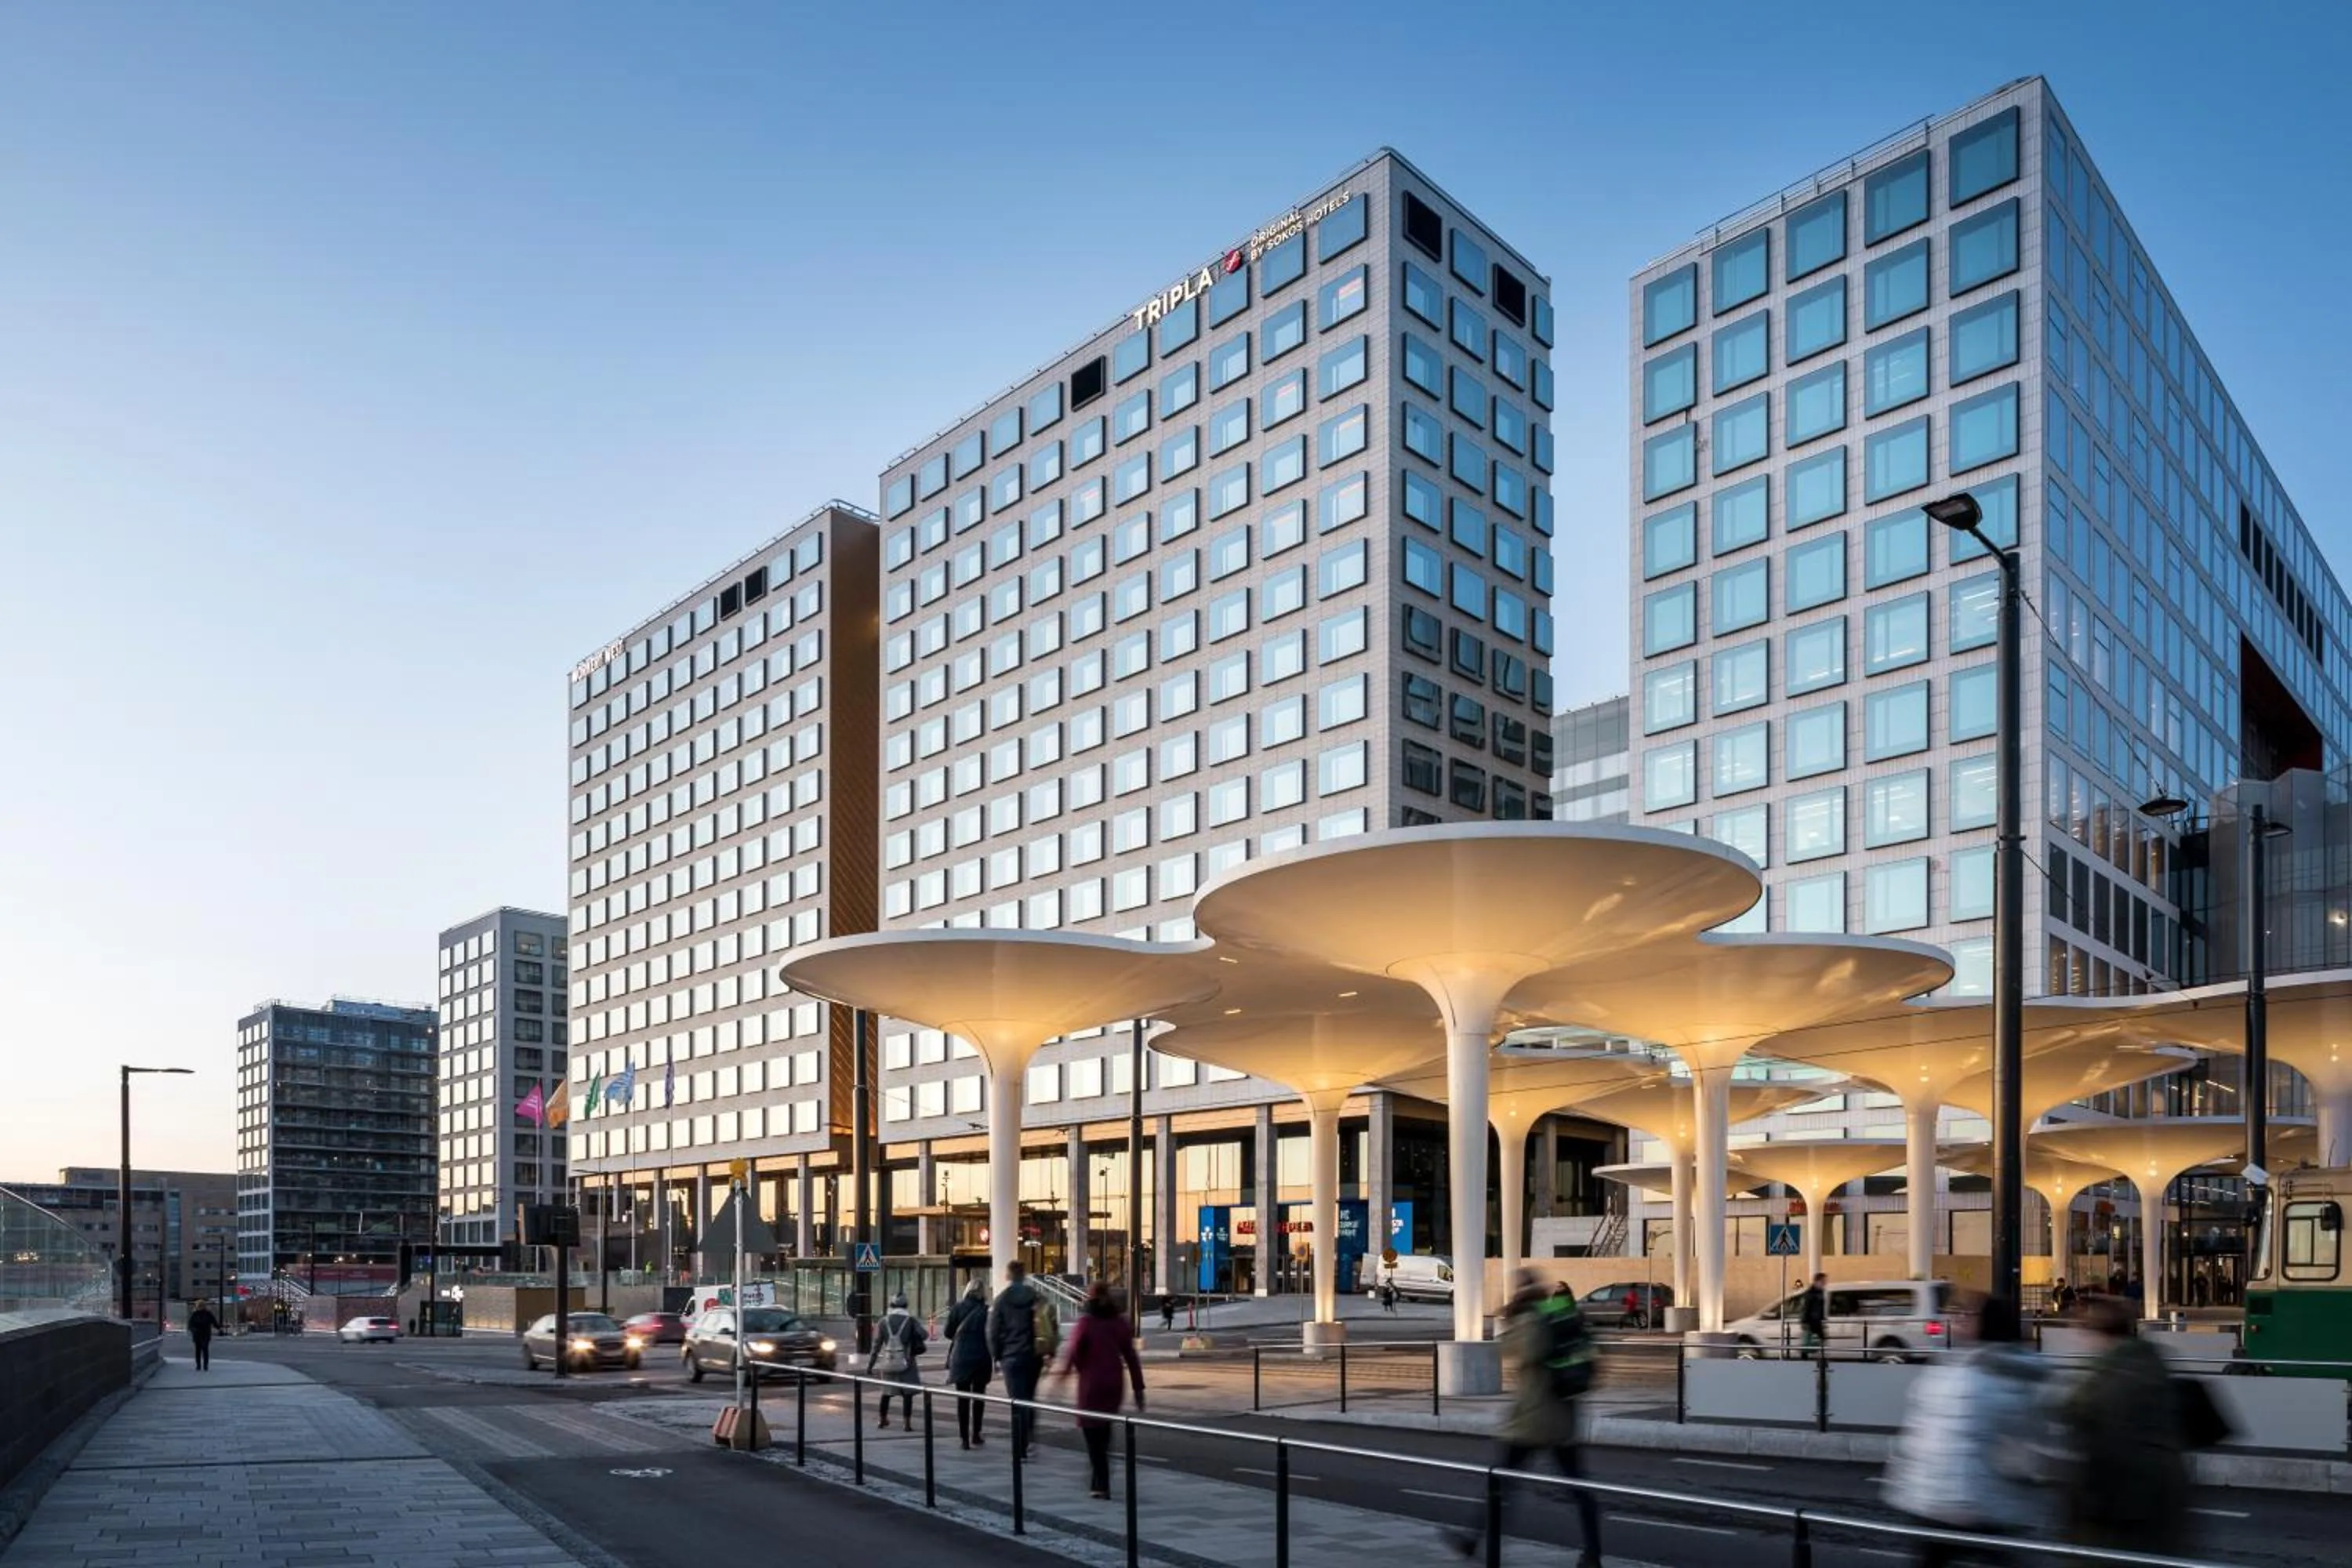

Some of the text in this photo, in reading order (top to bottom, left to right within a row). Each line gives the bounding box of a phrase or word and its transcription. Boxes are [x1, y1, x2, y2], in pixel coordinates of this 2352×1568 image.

[1250, 191, 1350, 261] BY SOKOS HOTELS
[1250, 210, 1302, 248] ORIGINAL
[1134, 267, 1214, 330] TRIPLA
